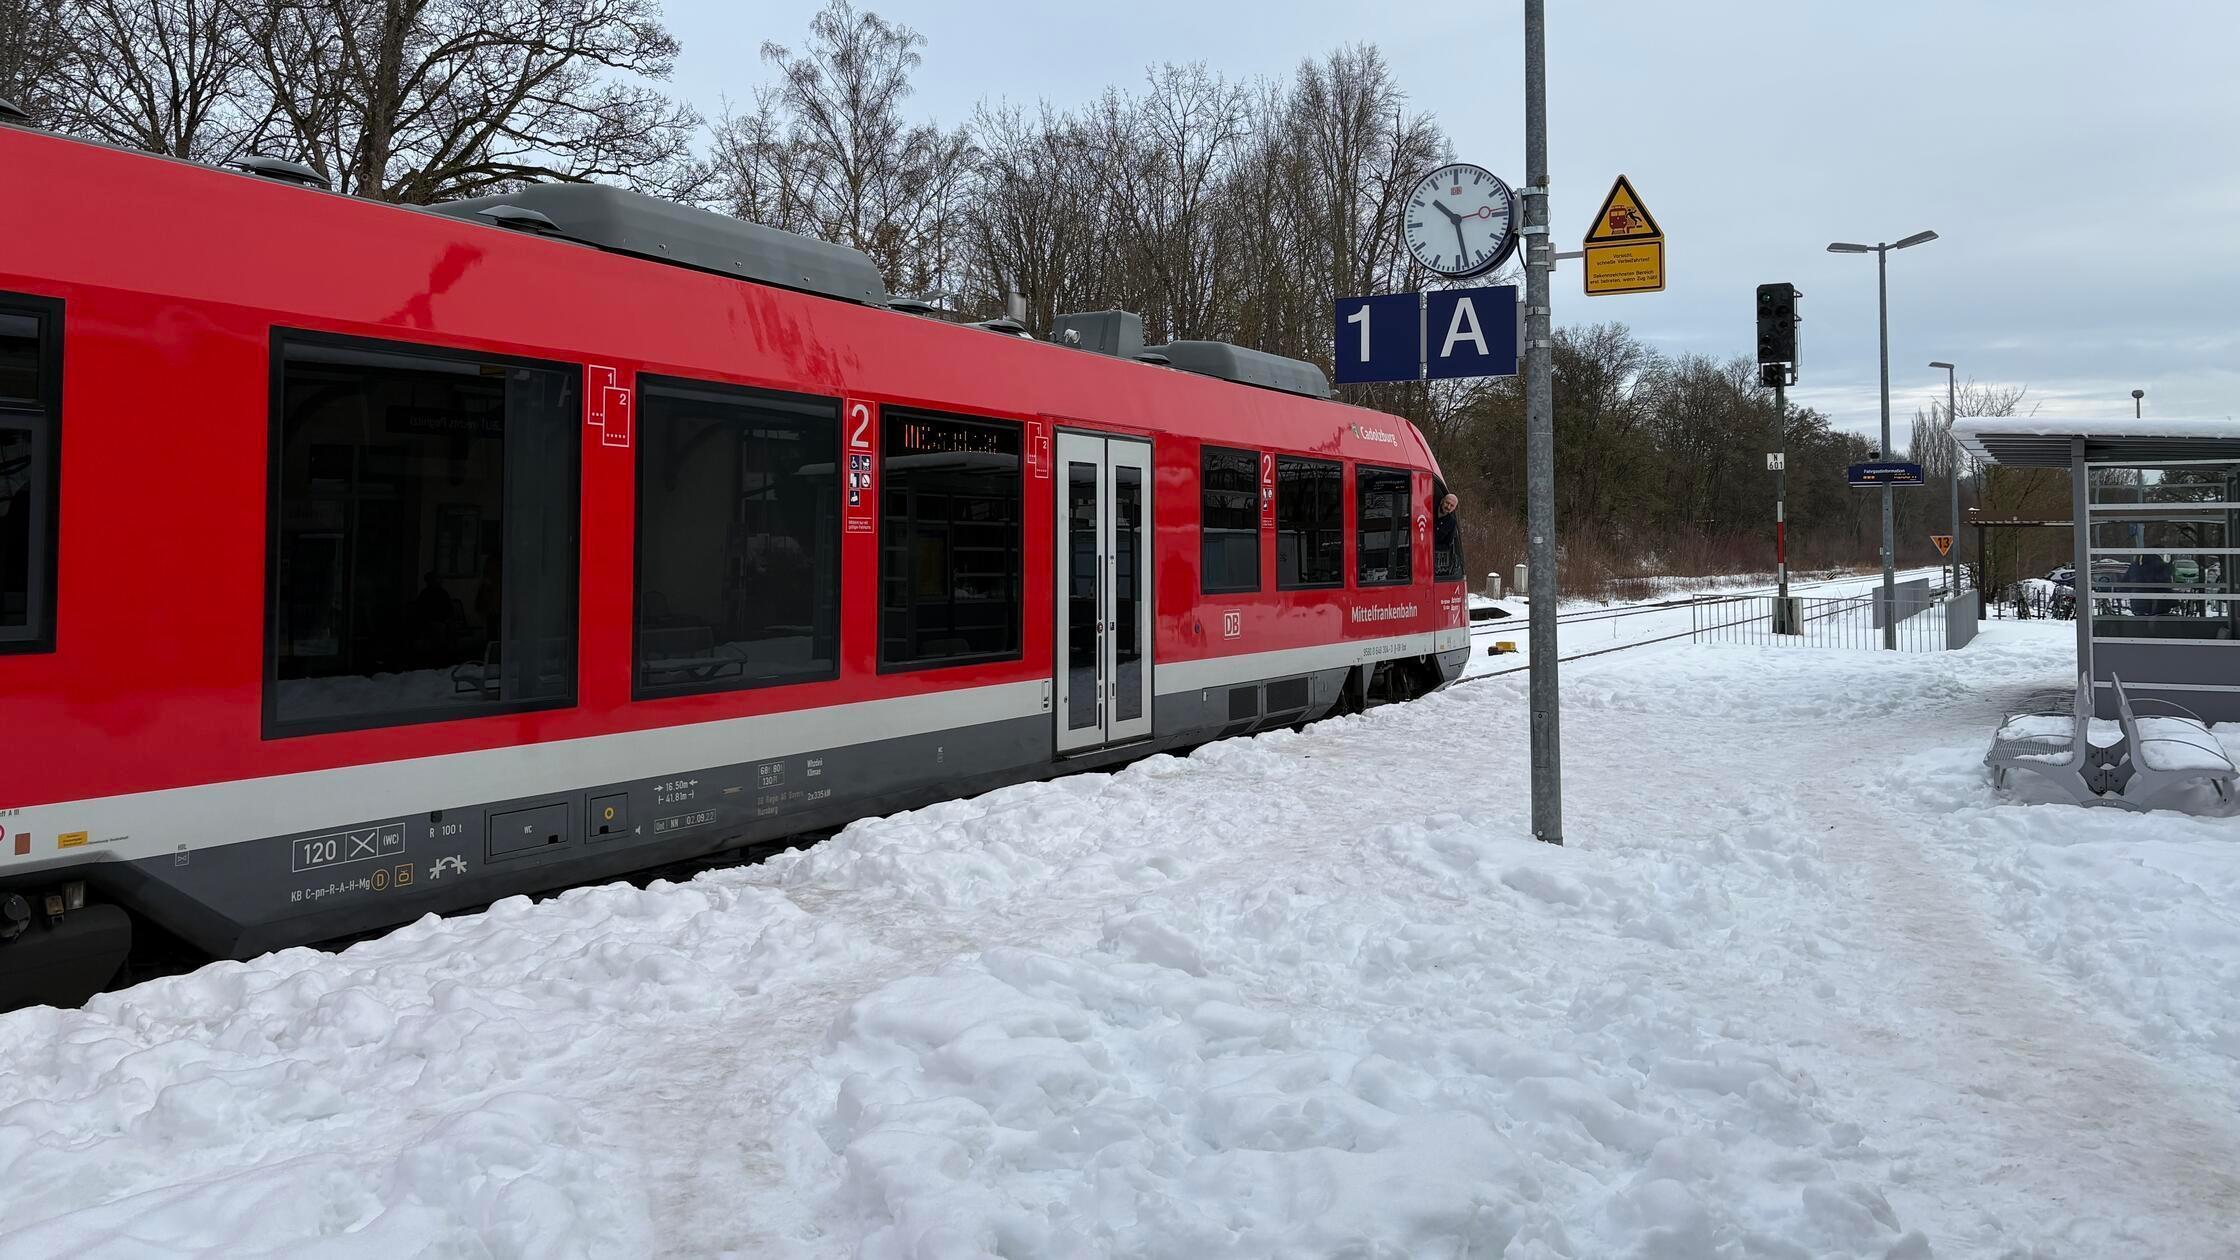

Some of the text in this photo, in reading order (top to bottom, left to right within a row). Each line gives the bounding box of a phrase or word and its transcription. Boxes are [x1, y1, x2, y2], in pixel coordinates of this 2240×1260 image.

[1347, 297, 1490, 362] 1 A
[607, 372, 613, 384] 1
[619, 393, 627, 405] 2
[851, 404, 869, 448] 2
[1042, 441, 1047, 450] 2
[1263, 454, 1272, 484] 2
[1769, 462, 1784, 470] 601
[1938, 537, 1950, 549] 13
[1351, 602, 1418, 624] Mittelfrankenbahn
[1225, 614, 1239, 635] DB
[430, 828, 435, 838] R
[442, 825, 456, 836] 100
[524, 825, 533, 835] WC
[304, 833, 400, 864] 120 (WC)
[291, 890, 302, 902] KB
